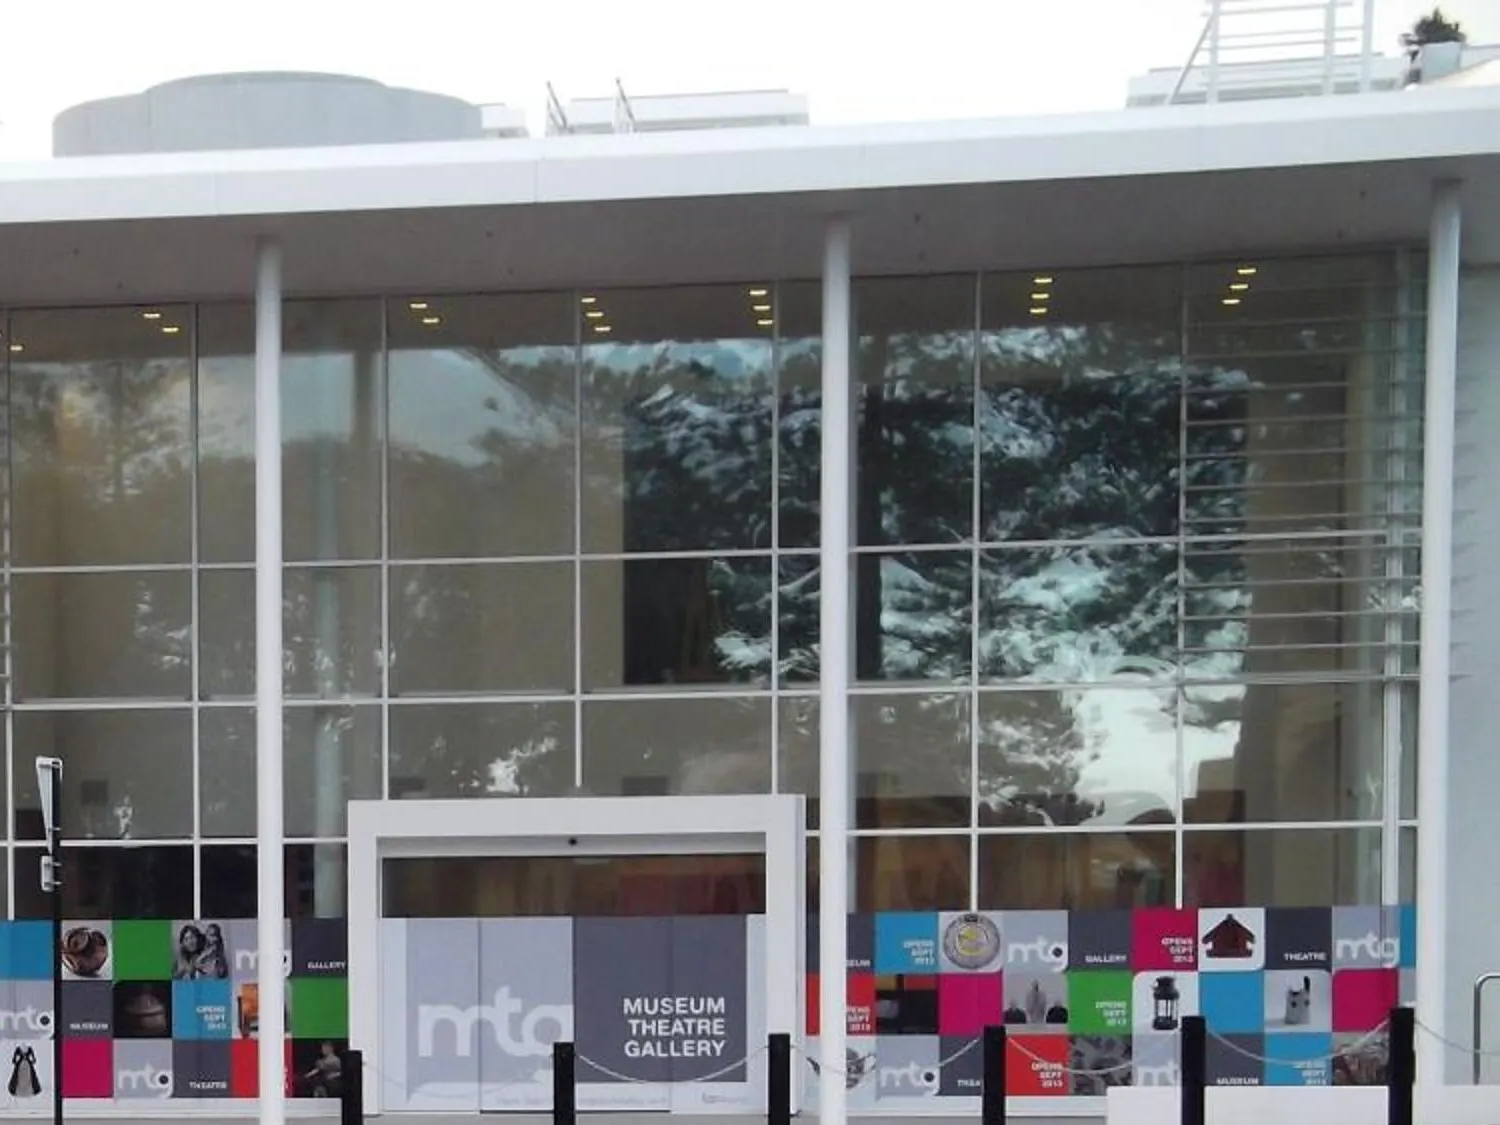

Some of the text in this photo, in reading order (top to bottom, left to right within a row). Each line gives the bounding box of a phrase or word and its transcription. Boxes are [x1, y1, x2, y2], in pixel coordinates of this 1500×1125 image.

[1007, 936, 1069, 973] mtg
[1084, 955, 1127, 963] GALLERY
[1284, 952, 1327, 961] THEATRE
[1336, 932, 1399, 968] mtg
[308, 961, 346, 970] GALLERY
[623, 997, 725, 1016] MUSEUM
[0, 1004, 55, 1040] mtg
[628, 1018, 725, 1036] THEATRE
[624, 1039, 726, 1058] GALLERY
[117, 1064, 173, 1098] mtg
[880, 1060, 940, 1096] mtg
[1137, 1060, 1181, 1086] mt
[189, 1081, 228, 1089] THEATRE
